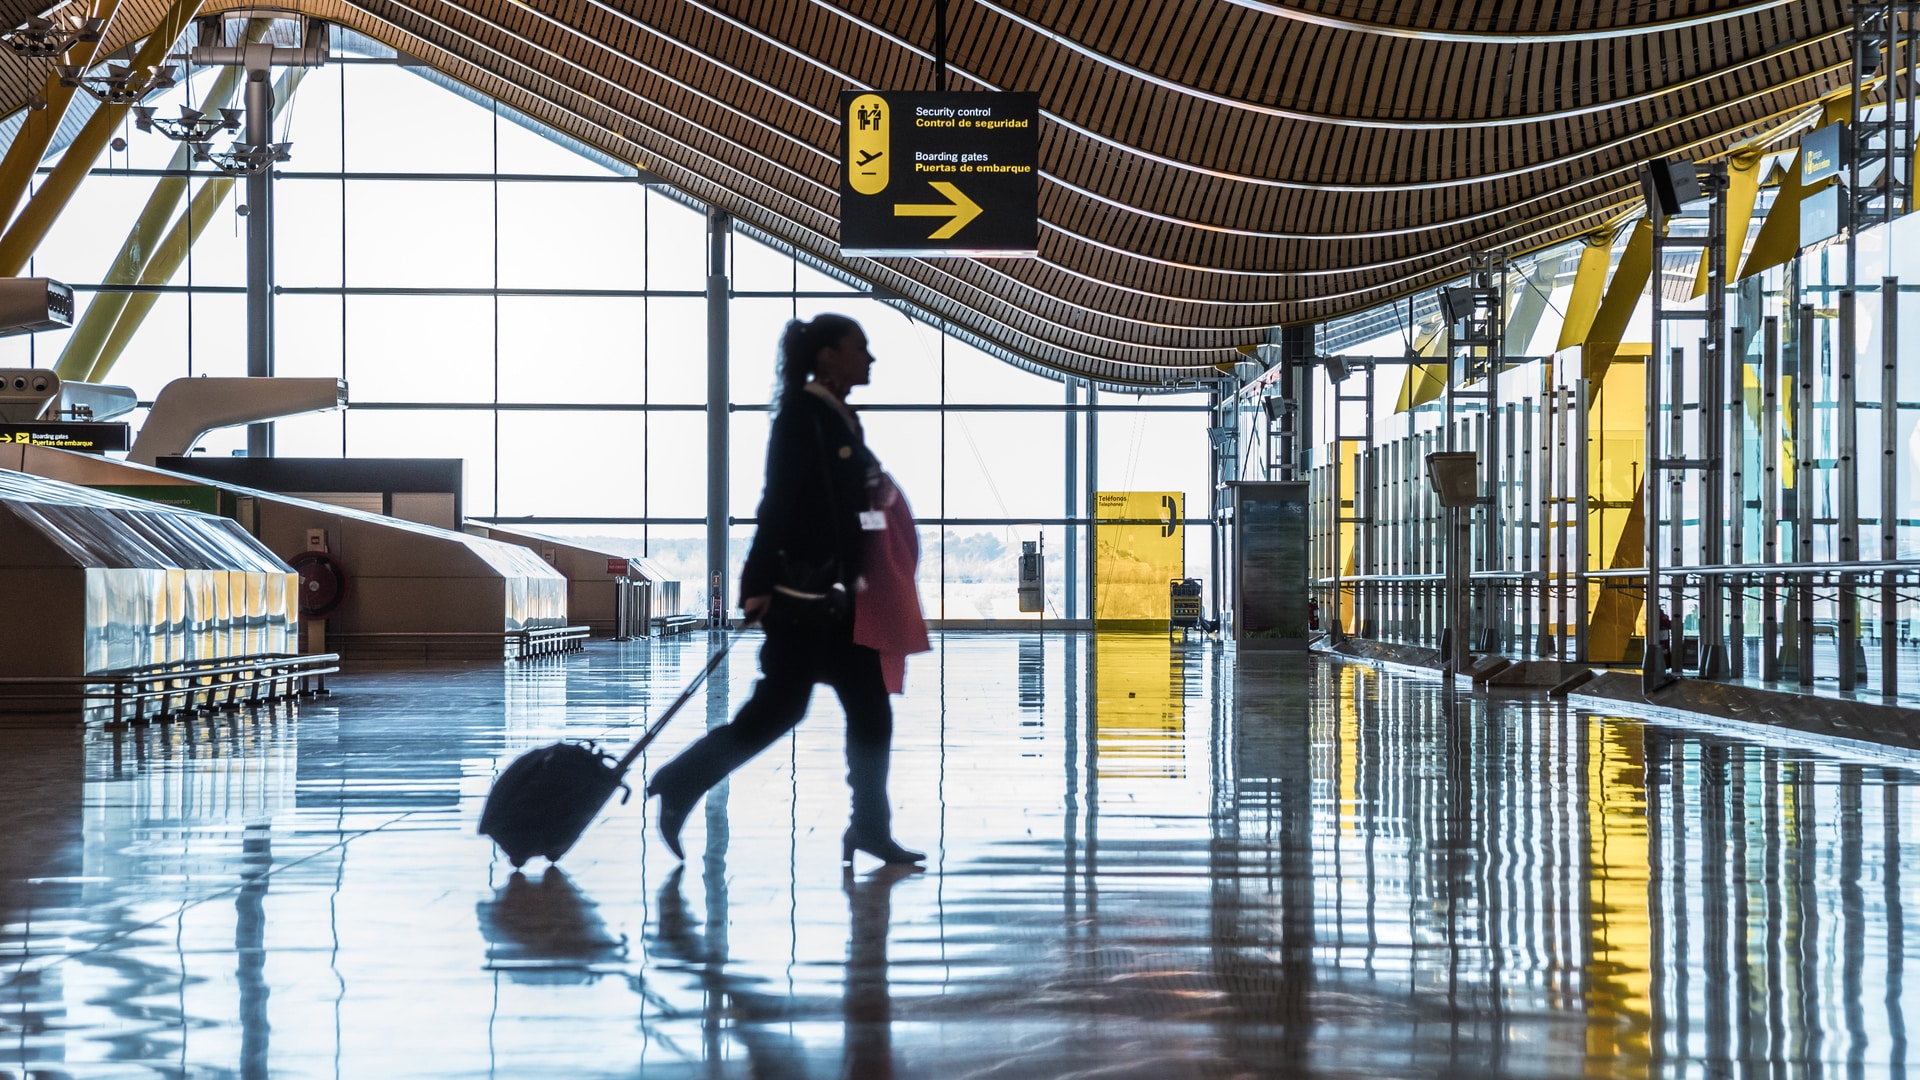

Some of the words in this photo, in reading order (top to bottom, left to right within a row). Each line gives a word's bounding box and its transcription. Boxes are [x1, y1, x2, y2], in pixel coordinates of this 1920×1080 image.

[916, 107, 955, 118] Security
[957, 107, 991, 117] control
[916, 118, 955, 127] Control
[958, 119, 972, 128] de
[975, 119, 1029, 129] seguridad
[915, 151, 958, 163] Boarding
[961, 152, 989, 163] gates
[915, 163, 957, 172] Puertas
[959, 163, 973, 172] de
[976, 163, 1031, 174] embarque
